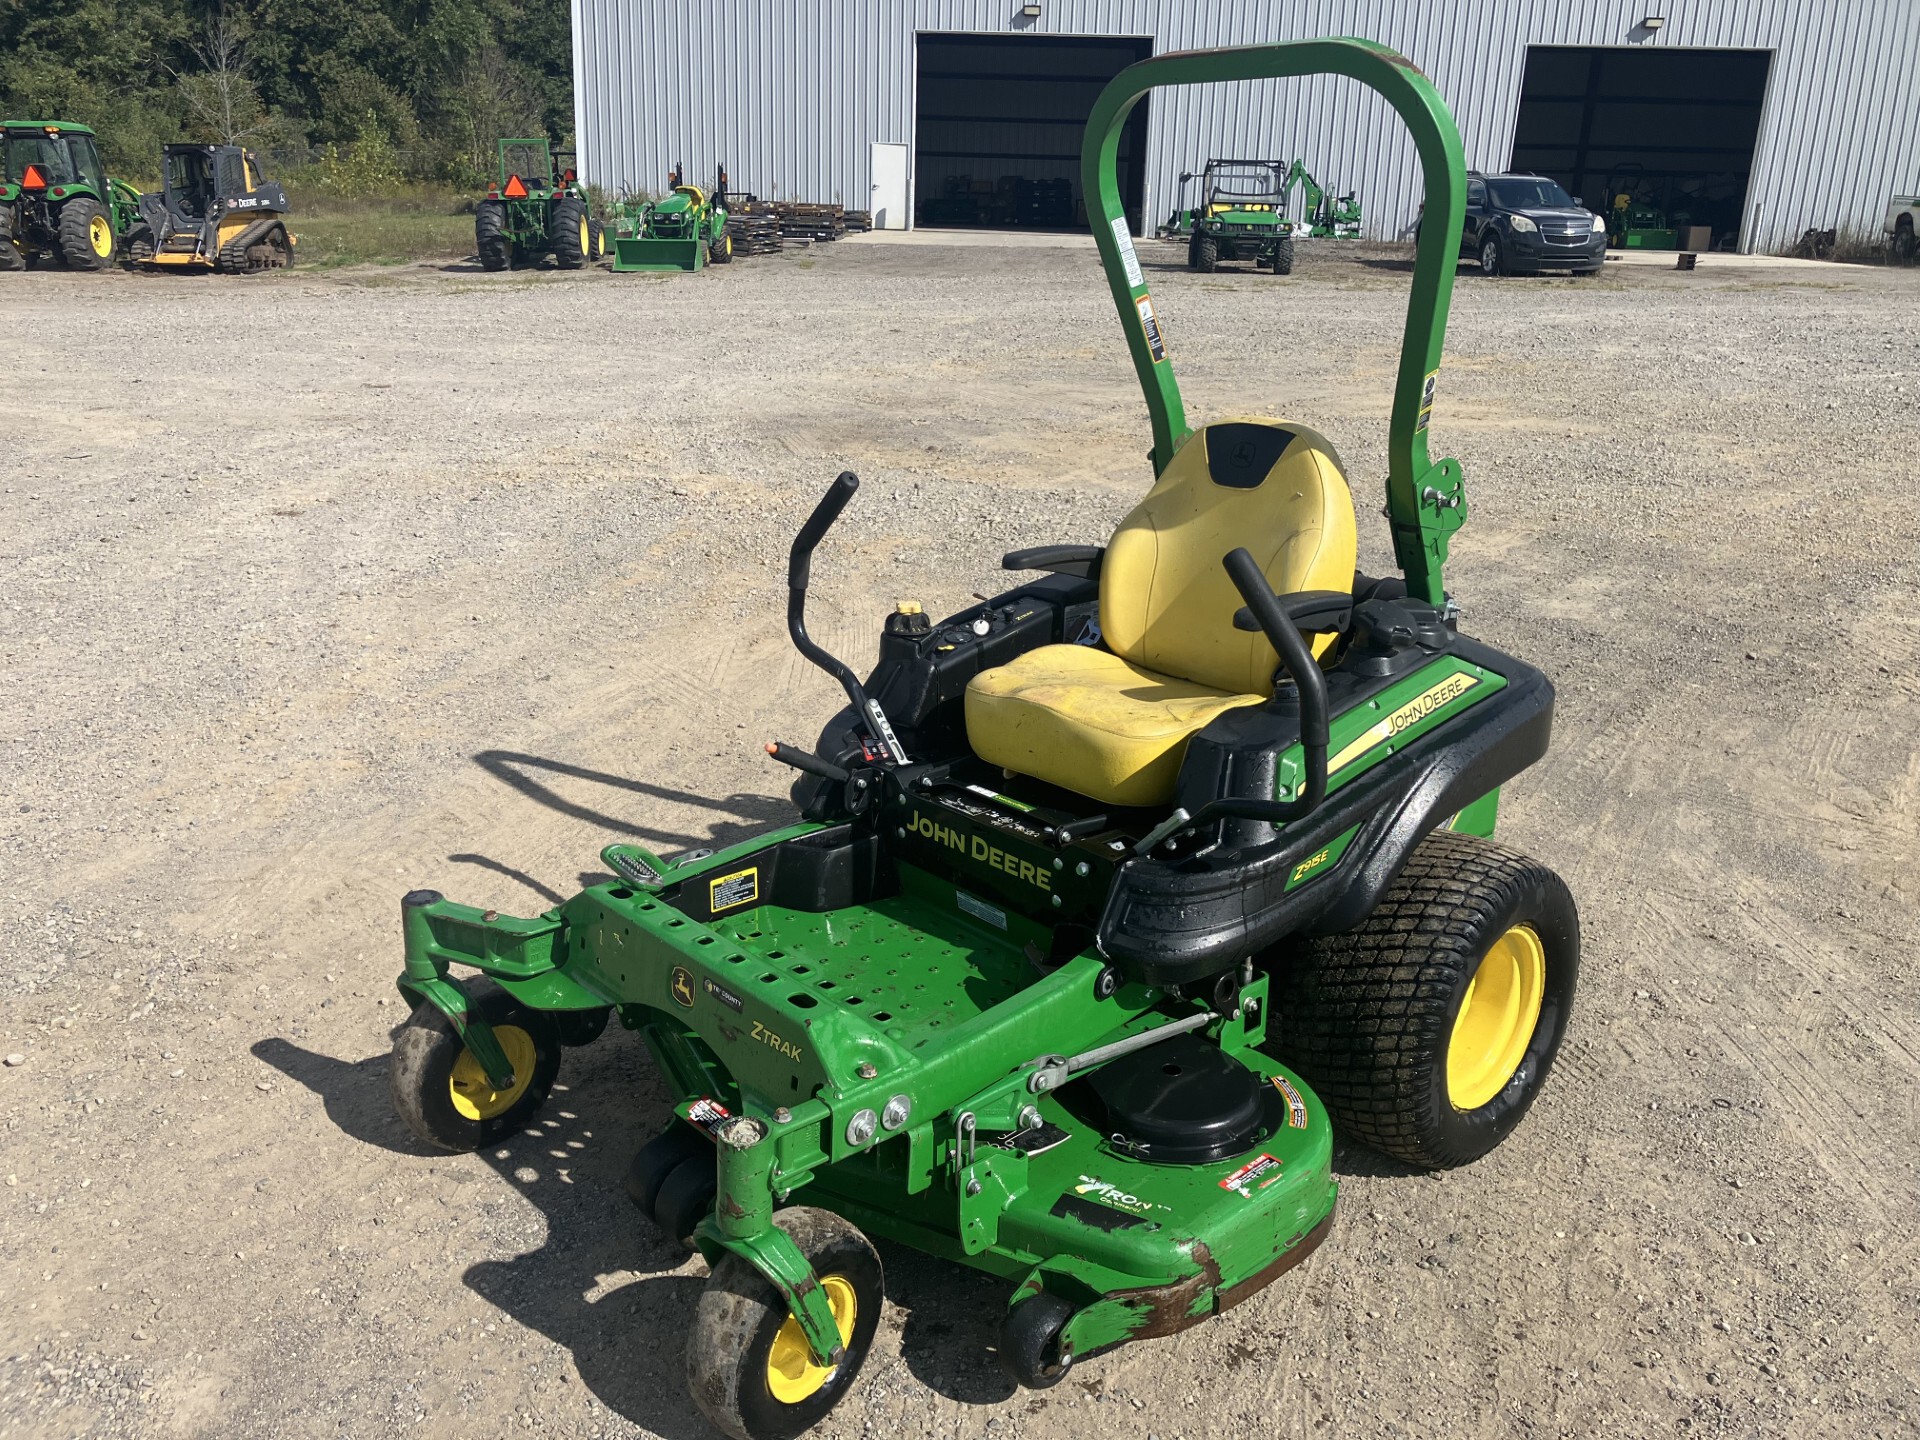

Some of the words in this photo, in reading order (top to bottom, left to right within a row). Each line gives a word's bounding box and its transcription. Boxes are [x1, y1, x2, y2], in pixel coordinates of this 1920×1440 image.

[238, 198, 257, 208] DEERE
[1389, 704, 1422, 734] JOHN
[1423, 679, 1463, 711] DEERE
[907, 810, 965, 853] JOHN
[971, 835, 1052, 891] DEERE
[1293, 849, 1329, 882] Z915E
[750, 1020, 802, 1063] ZTRAK
